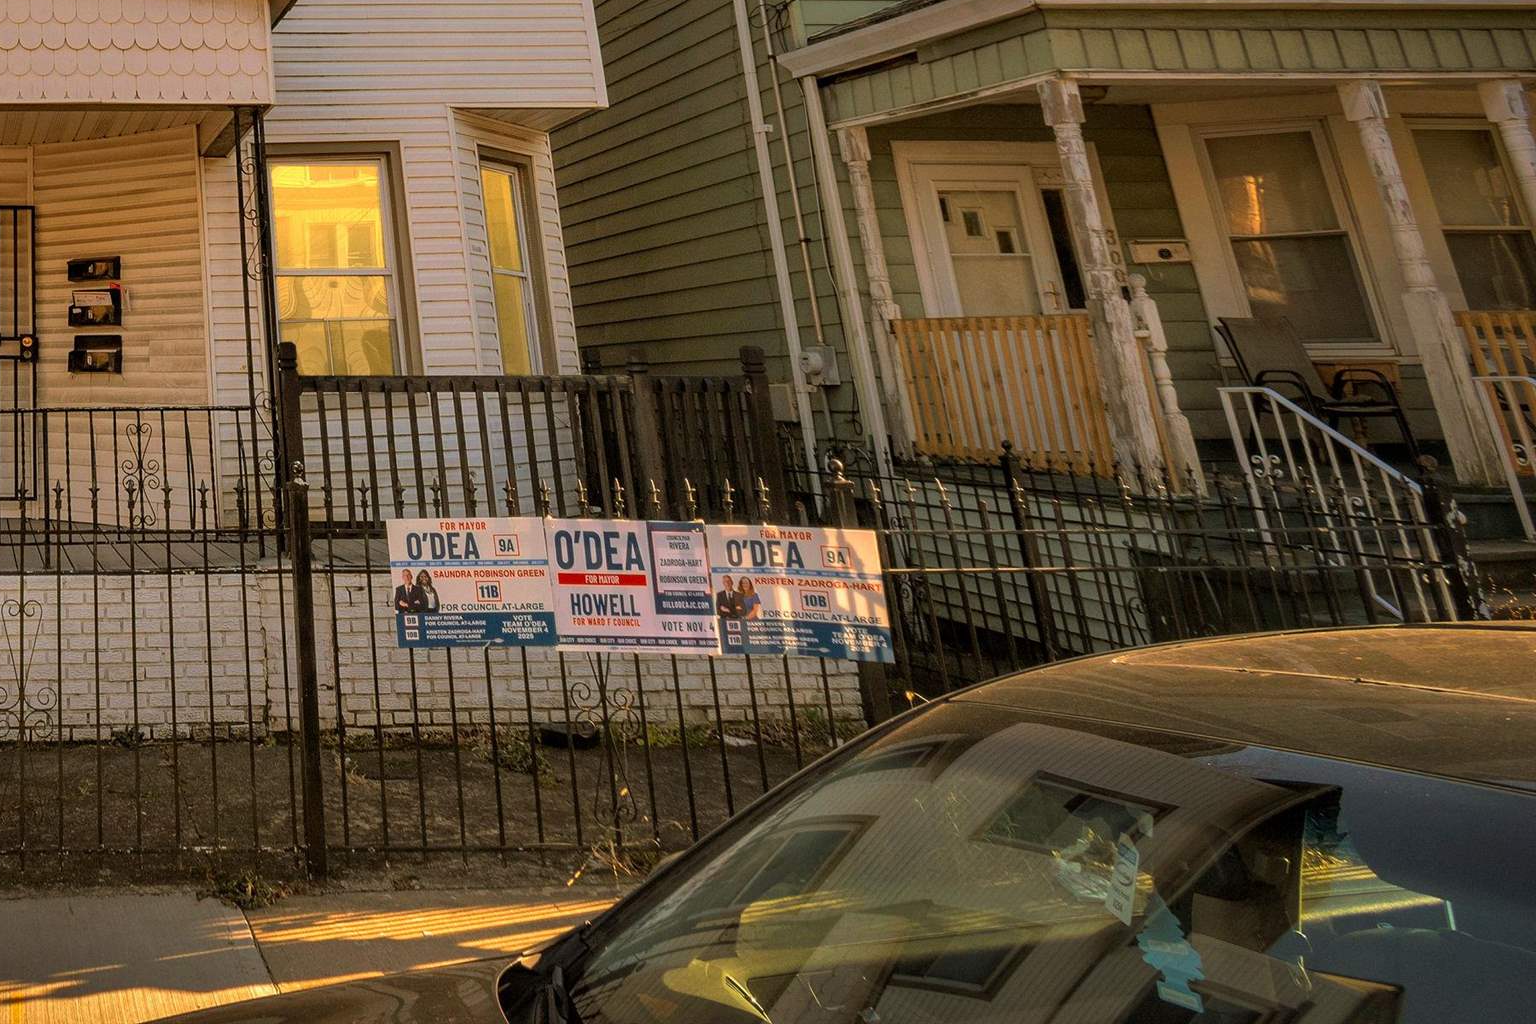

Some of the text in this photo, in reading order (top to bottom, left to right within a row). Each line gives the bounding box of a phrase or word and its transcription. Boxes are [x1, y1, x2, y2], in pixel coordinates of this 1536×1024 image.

[440, 522, 487, 531] FOR MAYOR
[760, 530, 812, 541] FOR MAYOR
[406, 532, 480, 560] O'DEA
[498, 539, 515, 552] 9A
[555, 530, 645, 570] O'DEA
[669, 542, 690, 550] RIVERA
[726, 540, 805, 568] O'DEA
[827, 550, 846, 565] 9A
[660, 559, 703, 568] ZADROGA-HART
[433, 569, 545, 578] SAUNDRA ROBINSON GREEN
[585, 575, 620, 585] FOR MAYOR
[660, 576, 707, 585] ROBINSON GREEN
[754, 577, 881, 592] KRISTEN ZADROGA-HART
[479, 585, 499, 598] 11B
[571, 593, 641, 617] HOWELL
[803, 594, 827, 608] 10B
[462, 603, 499, 611] COUNCIL
[501, 603, 544, 611] AT-LARGE
[573, 617, 585, 626] FOR
[588, 617, 605, 626] WARD
[613, 618, 641, 627] COUNCIL
[762, 609, 881, 624] FOR COUNCIL AT-LARGE
[662, 621, 715, 632] VOTE NOV. 4
[844, 626, 868, 634] VOTE
[832, 638, 880, 647] NOVEMBER
